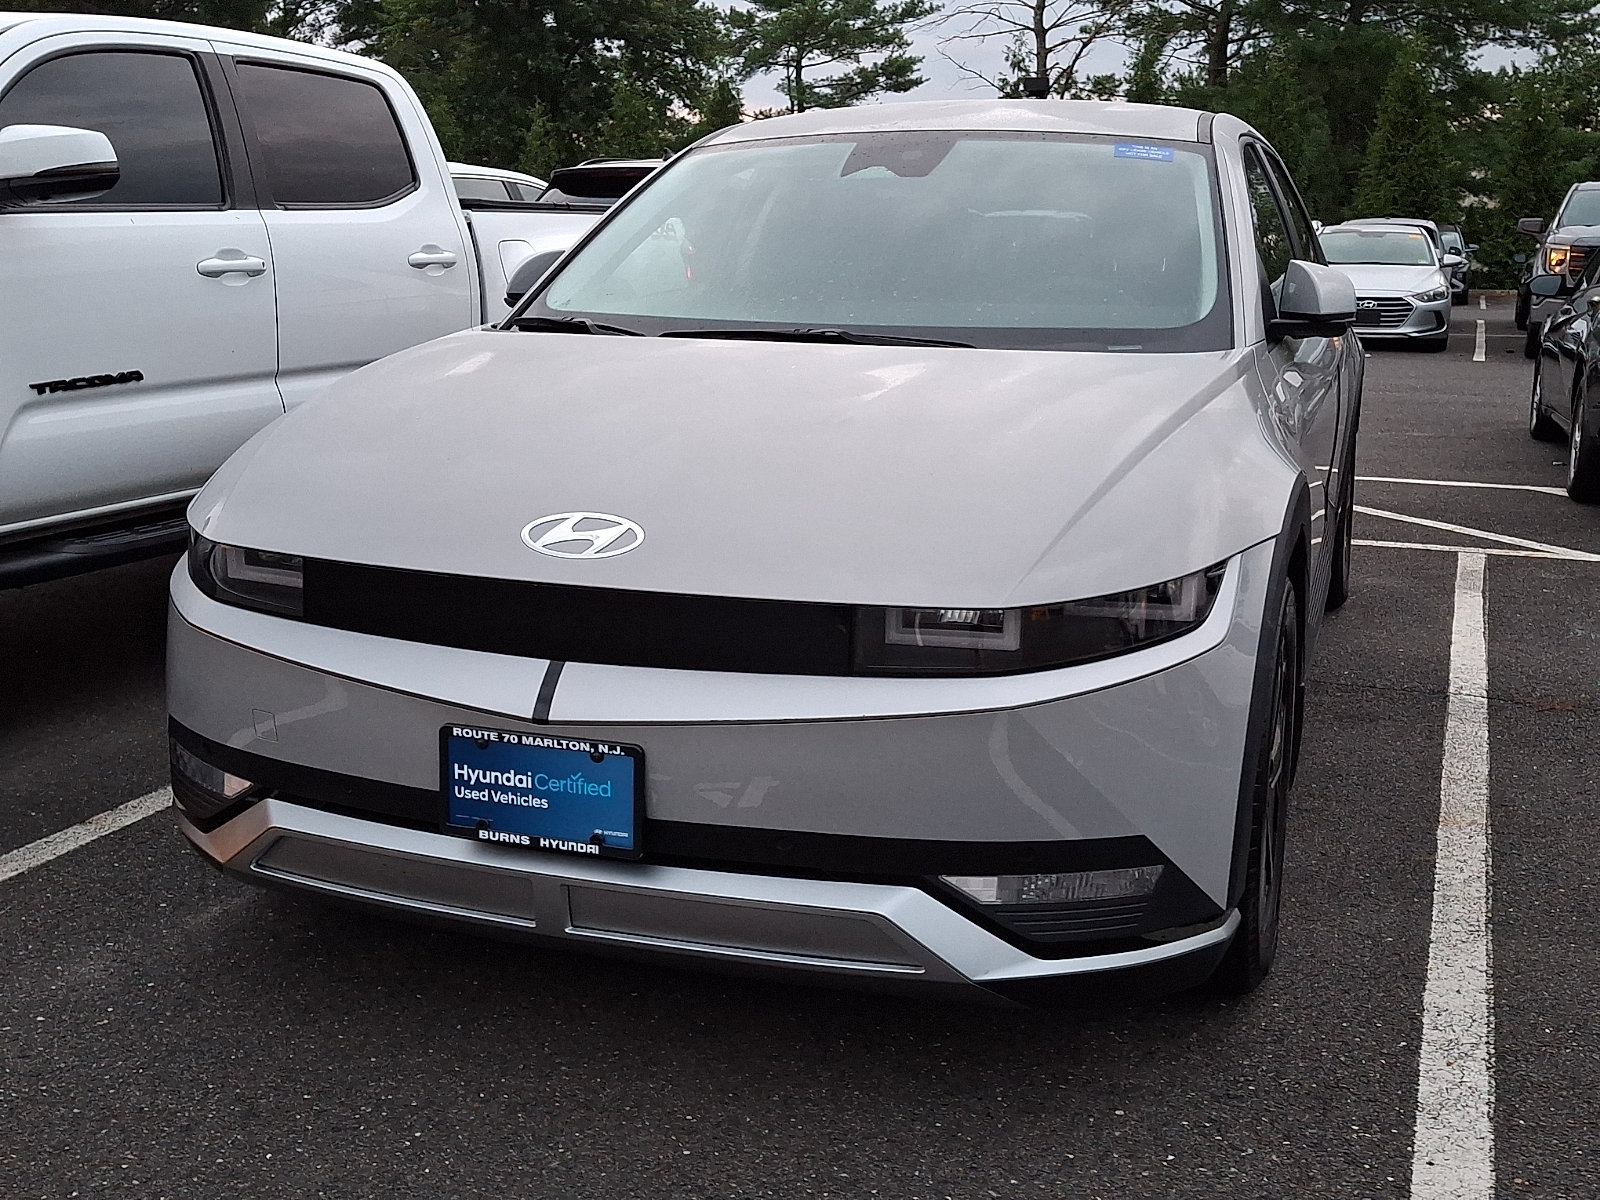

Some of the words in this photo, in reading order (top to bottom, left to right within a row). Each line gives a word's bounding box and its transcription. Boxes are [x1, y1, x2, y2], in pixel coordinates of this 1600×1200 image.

[29, 370, 144, 395] TACOMA
[452, 727, 499, 742] ROUTE
[502, 733, 518, 744] 70
[521, 735, 595, 753] MARLTON,
[598, 744, 625, 756] N.J.
[454, 763, 533, 789] Hyundai
[534, 772, 611, 798] Certified
[454, 785, 489, 802] Used
[491, 790, 549, 809] Vehicles
[478, 829, 531, 845] BURNS
[539, 837, 600, 855] HYUNDAI
